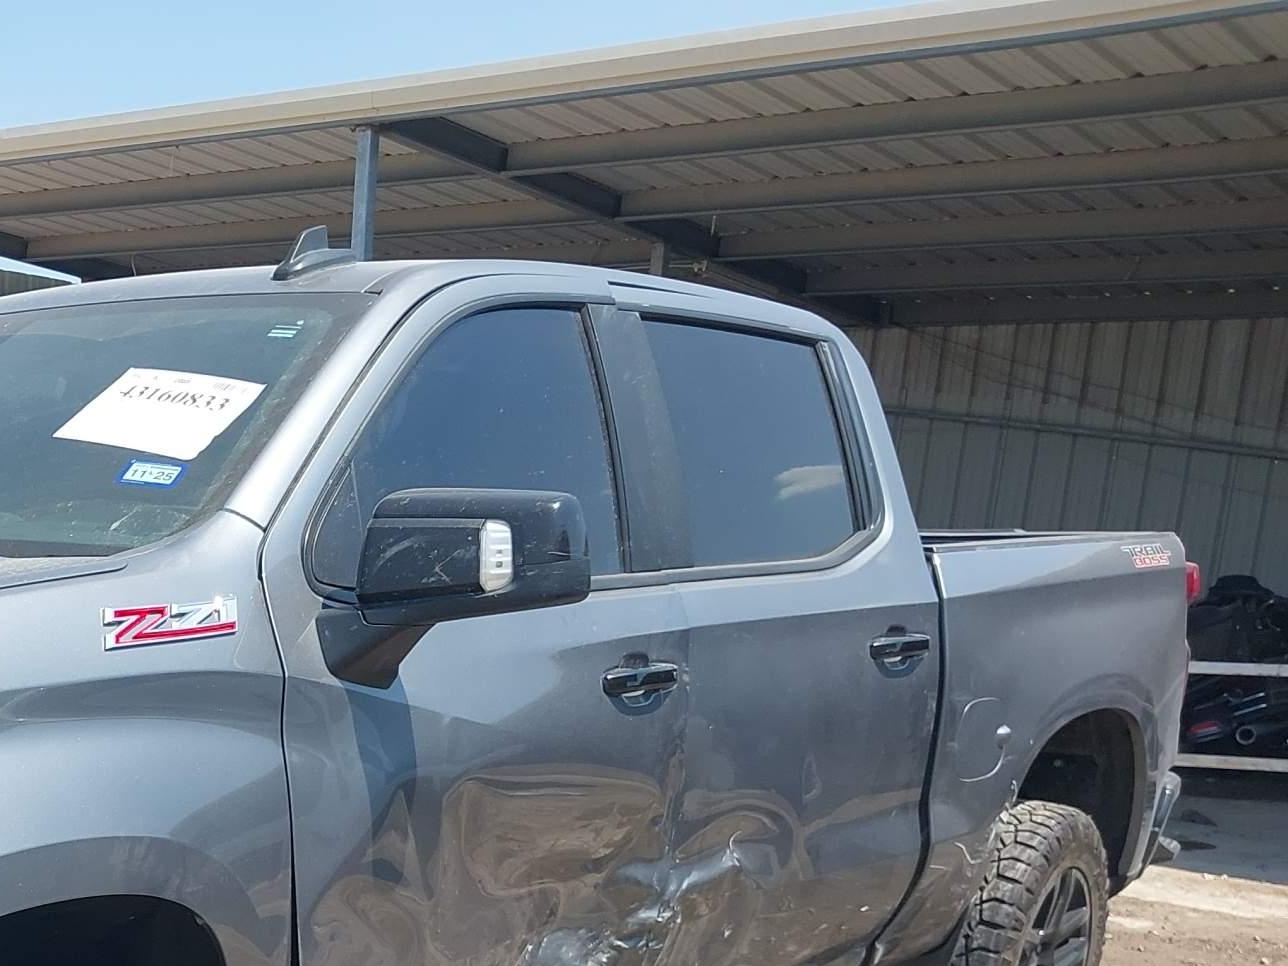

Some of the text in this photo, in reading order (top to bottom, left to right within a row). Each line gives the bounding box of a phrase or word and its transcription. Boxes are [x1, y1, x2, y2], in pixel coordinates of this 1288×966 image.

[119, 385, 231, 411] 43160833
[1120, 543, 1171, 558] TRAIL
[1133, 555, 1170, 568] BOSS
